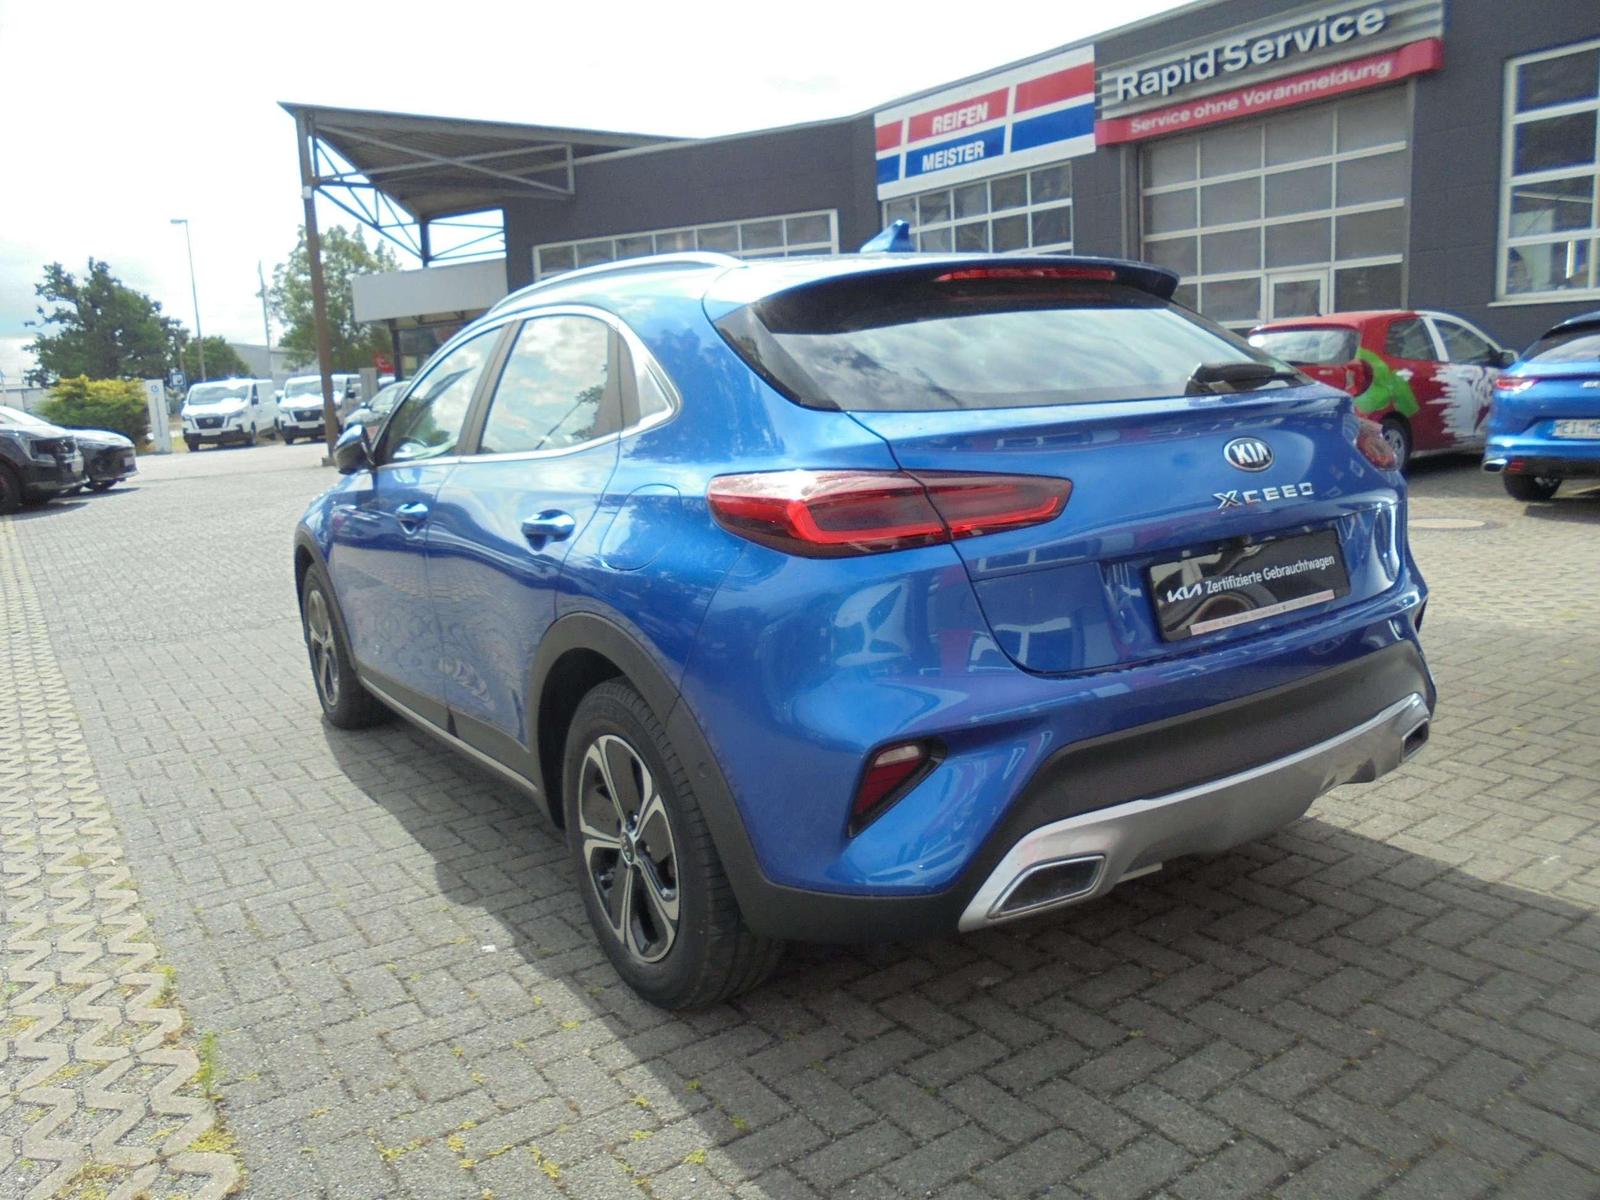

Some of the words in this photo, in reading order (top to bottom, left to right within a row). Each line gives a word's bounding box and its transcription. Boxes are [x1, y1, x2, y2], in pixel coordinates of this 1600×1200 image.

[1131, 108, 1190, 134] Service
[1193, 94, 1239, 119] ohne
[1243, 60, 1392, 108] Voranmeldung
[932, 101, 989, 135] REIFEN
[922, 140, 985, 172] MEISTER
[1231, 442, 1271, 465] KIA
[1205, 571, 1263, 594] Zertifizierte
[1263, 555, 1335, 581] Gebrauchtwagen
